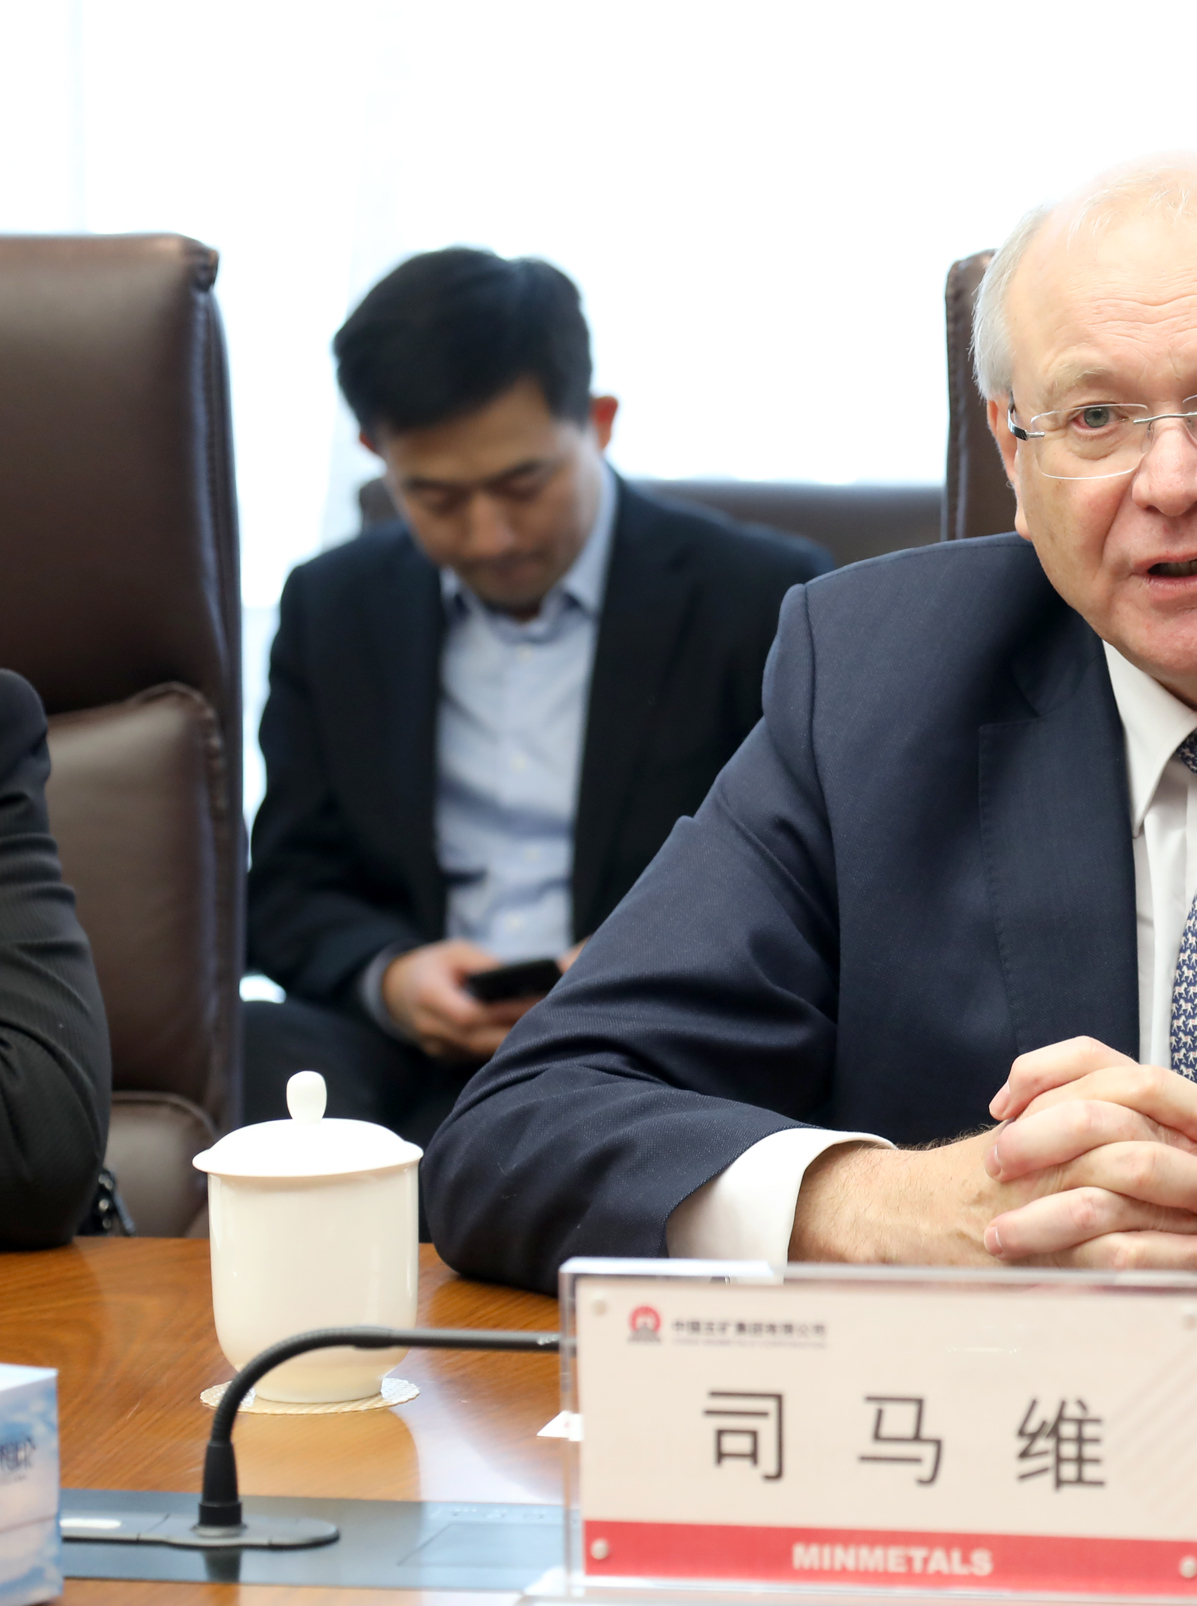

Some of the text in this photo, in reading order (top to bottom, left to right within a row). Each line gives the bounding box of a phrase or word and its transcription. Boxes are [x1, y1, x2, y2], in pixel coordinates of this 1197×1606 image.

[702, 1391, 1108, 1492] 司马维
[791, 1542, 994, 1577] MINMETALS
